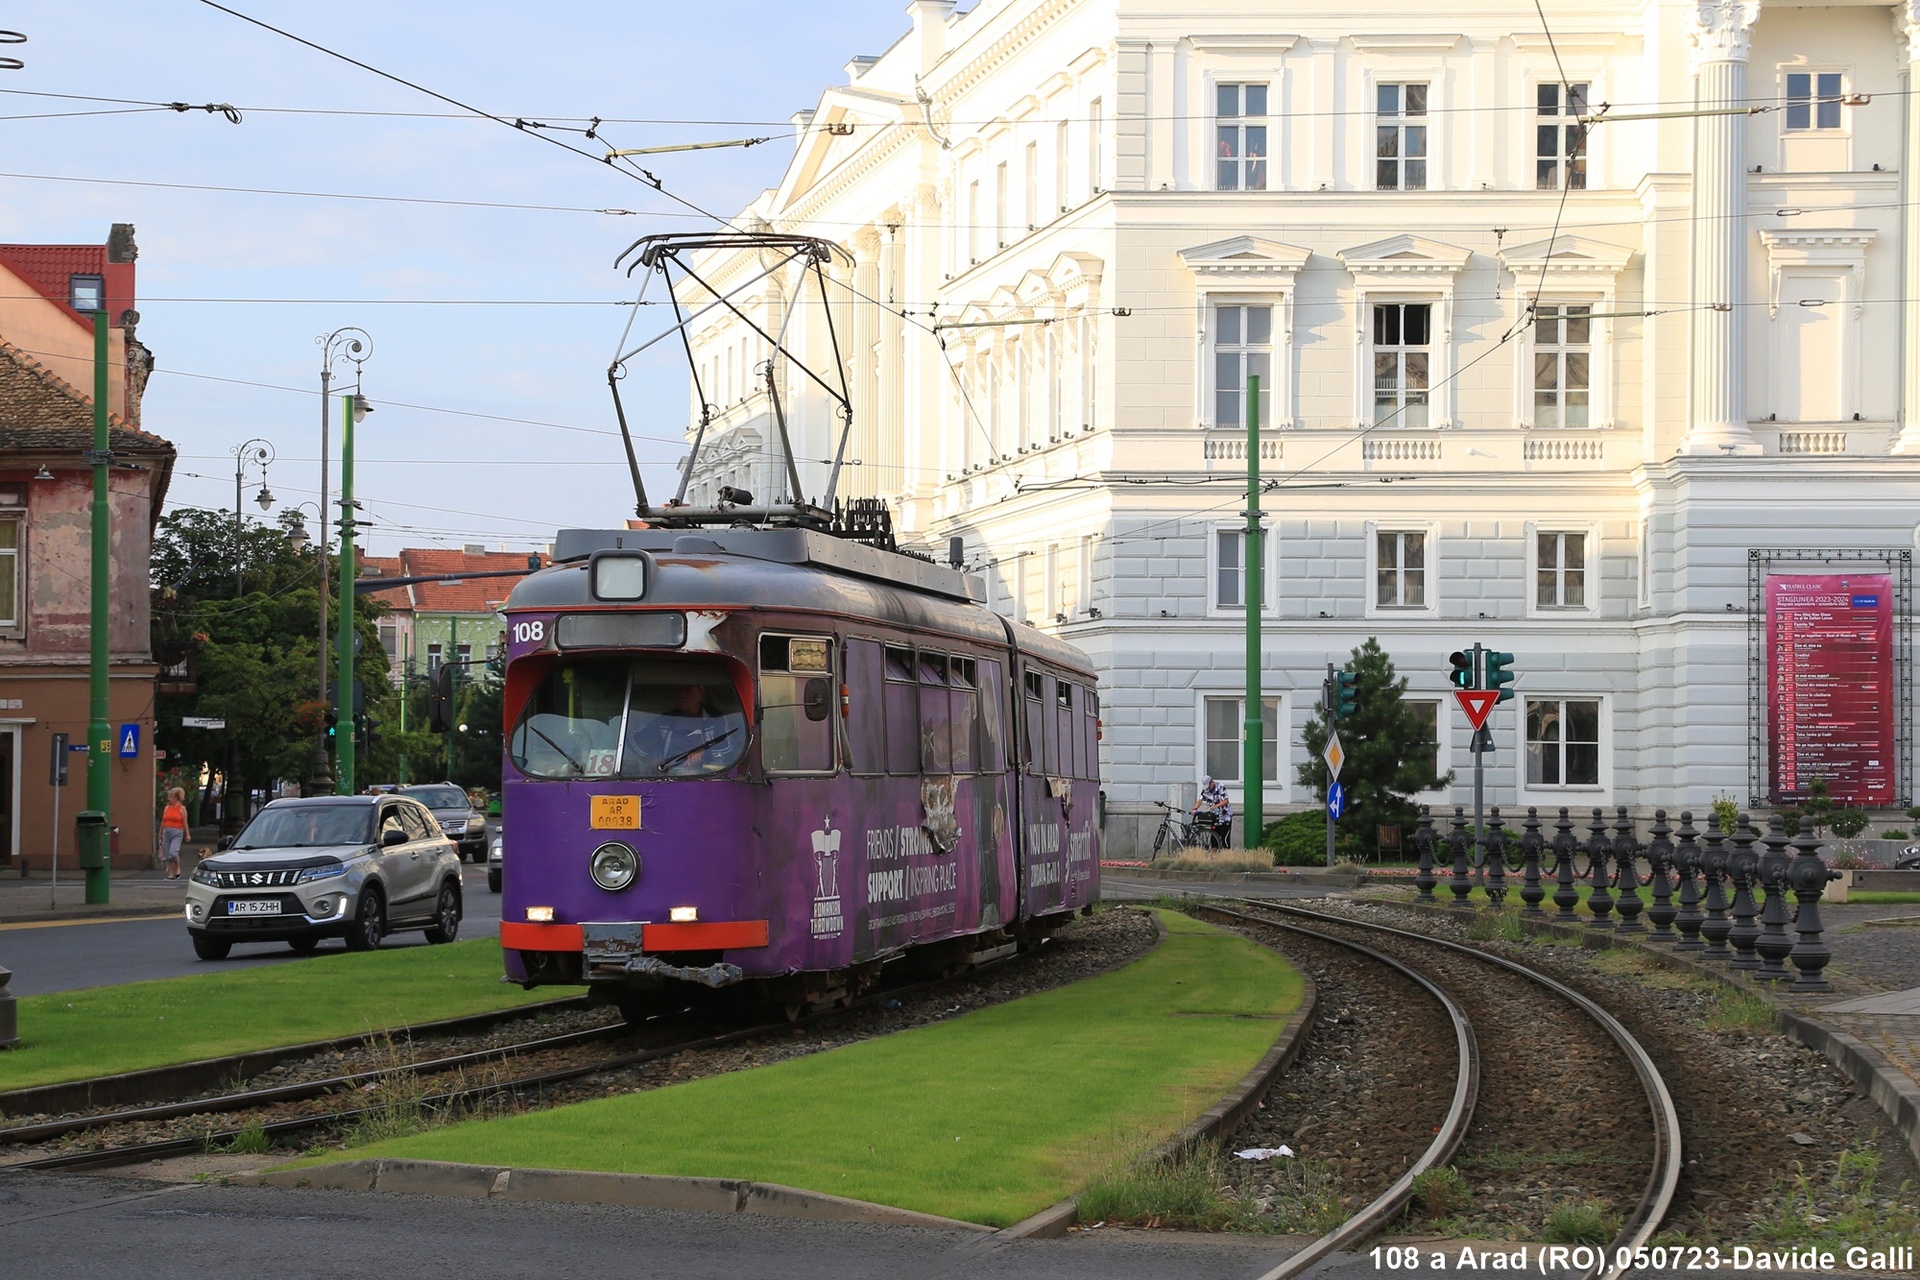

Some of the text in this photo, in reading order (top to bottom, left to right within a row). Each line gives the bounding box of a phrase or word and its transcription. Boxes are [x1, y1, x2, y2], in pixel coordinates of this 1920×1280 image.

[513, 621, 543, 643] 108
[587, 754, 614, 774] 18
[610, 806, 622, 814] AR
[598, 816, 632, 826] 00038
[867, 828, 894, 860] FRIENDS
[868, 869, 904, 903] SUPPORT
[940, 862, 956, 892] PLACE
[235, 902, 279, 912] AR 15 ZHH
[810, 916, 844, 934] THROWDOWN
